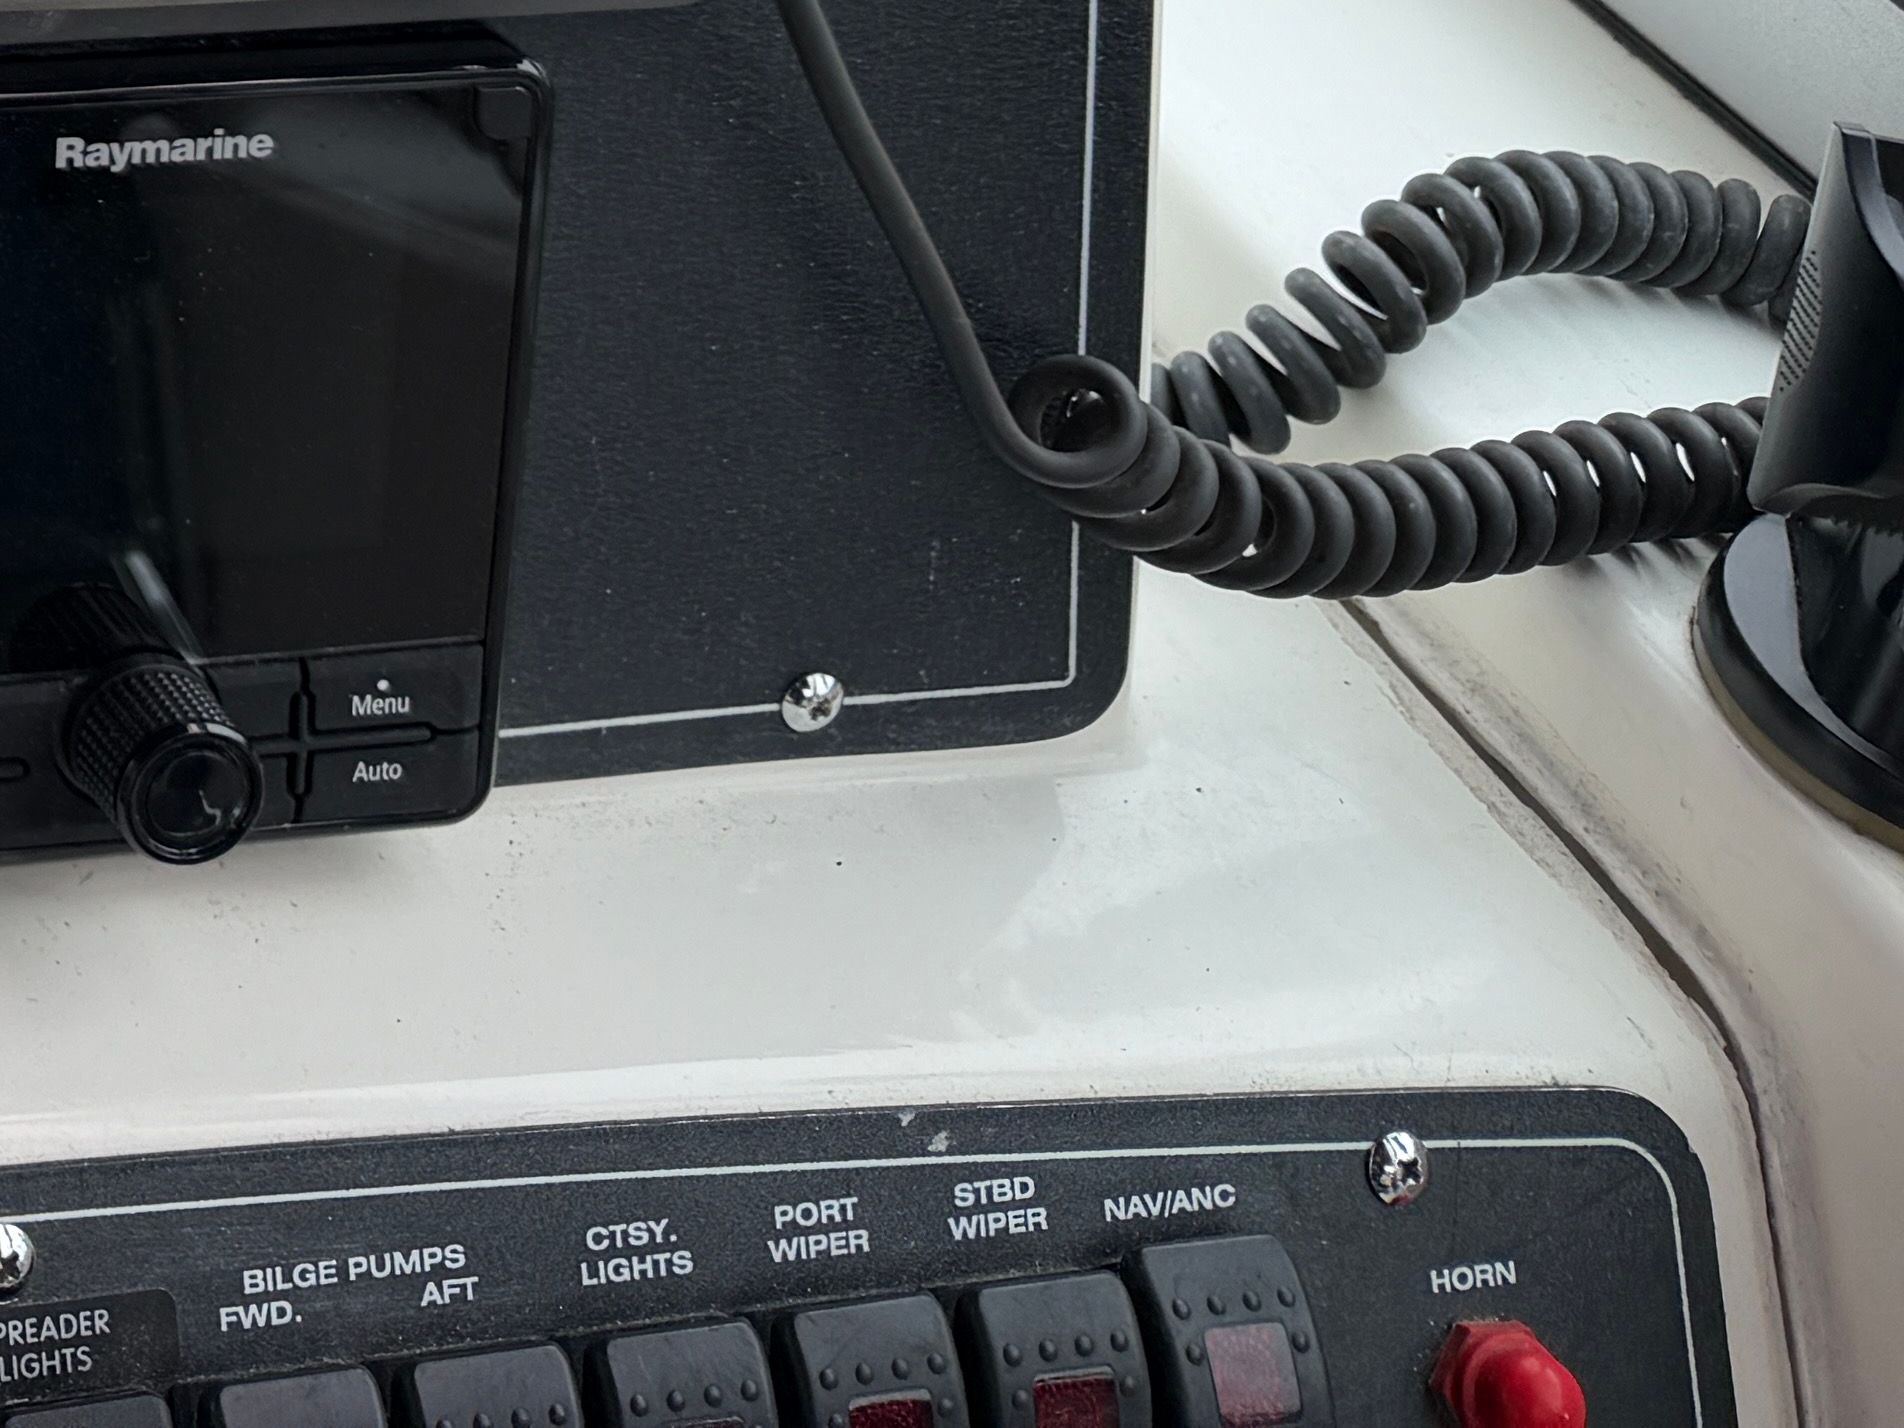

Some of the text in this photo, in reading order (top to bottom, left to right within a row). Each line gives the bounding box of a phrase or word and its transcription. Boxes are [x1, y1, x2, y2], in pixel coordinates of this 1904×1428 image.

[55, 128, 274, 173] Raymarine
[352, 694, 410, 716] Menu
[352, 760, 403, 783] Auto
[954, 1176, 1036, 1207] STBD
[1103, 1184, 1236, 1222] NAV/ANC
[773, 1196, 859, 1230] PORT
[947, 1207, 1049, 1241] WIPER
[586, 1218, 678, 1251] CTSY.
[766, 1229, 871, 1263] WIPER
[242, 1244, 467, 1295] BILGE PUMPS
[580, 1250, 694, 1286] LIGHTS
[1430, 1260, 1517, 1294] HORN
[420, 1276, 480, 1307] AFT
[219, 1300, 303, 1332] FWD.
